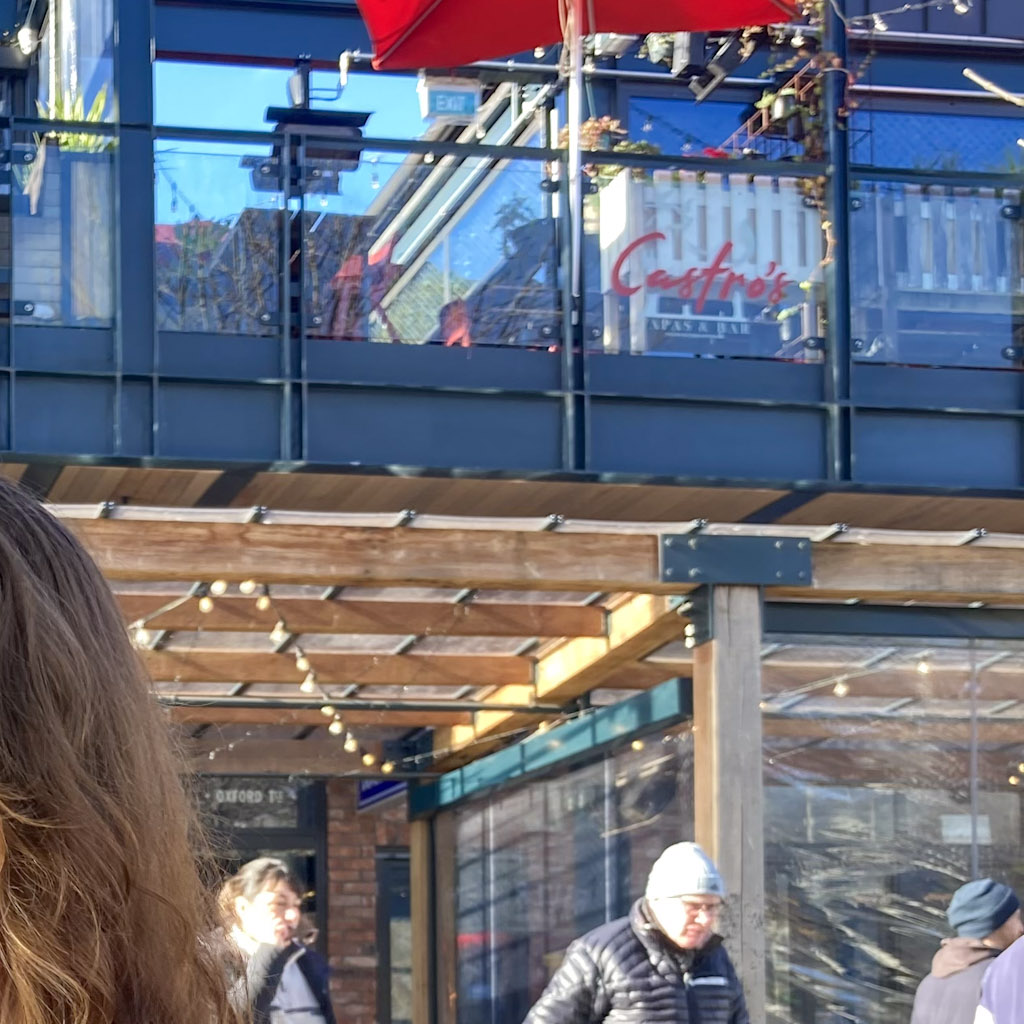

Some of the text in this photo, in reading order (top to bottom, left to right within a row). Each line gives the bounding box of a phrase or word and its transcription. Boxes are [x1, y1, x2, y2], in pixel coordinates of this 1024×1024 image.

[435, 94, 465, 111] EXIT
[610, 231, 795, 313] Castro's
[215, 789, 263, 803] OXFORD
